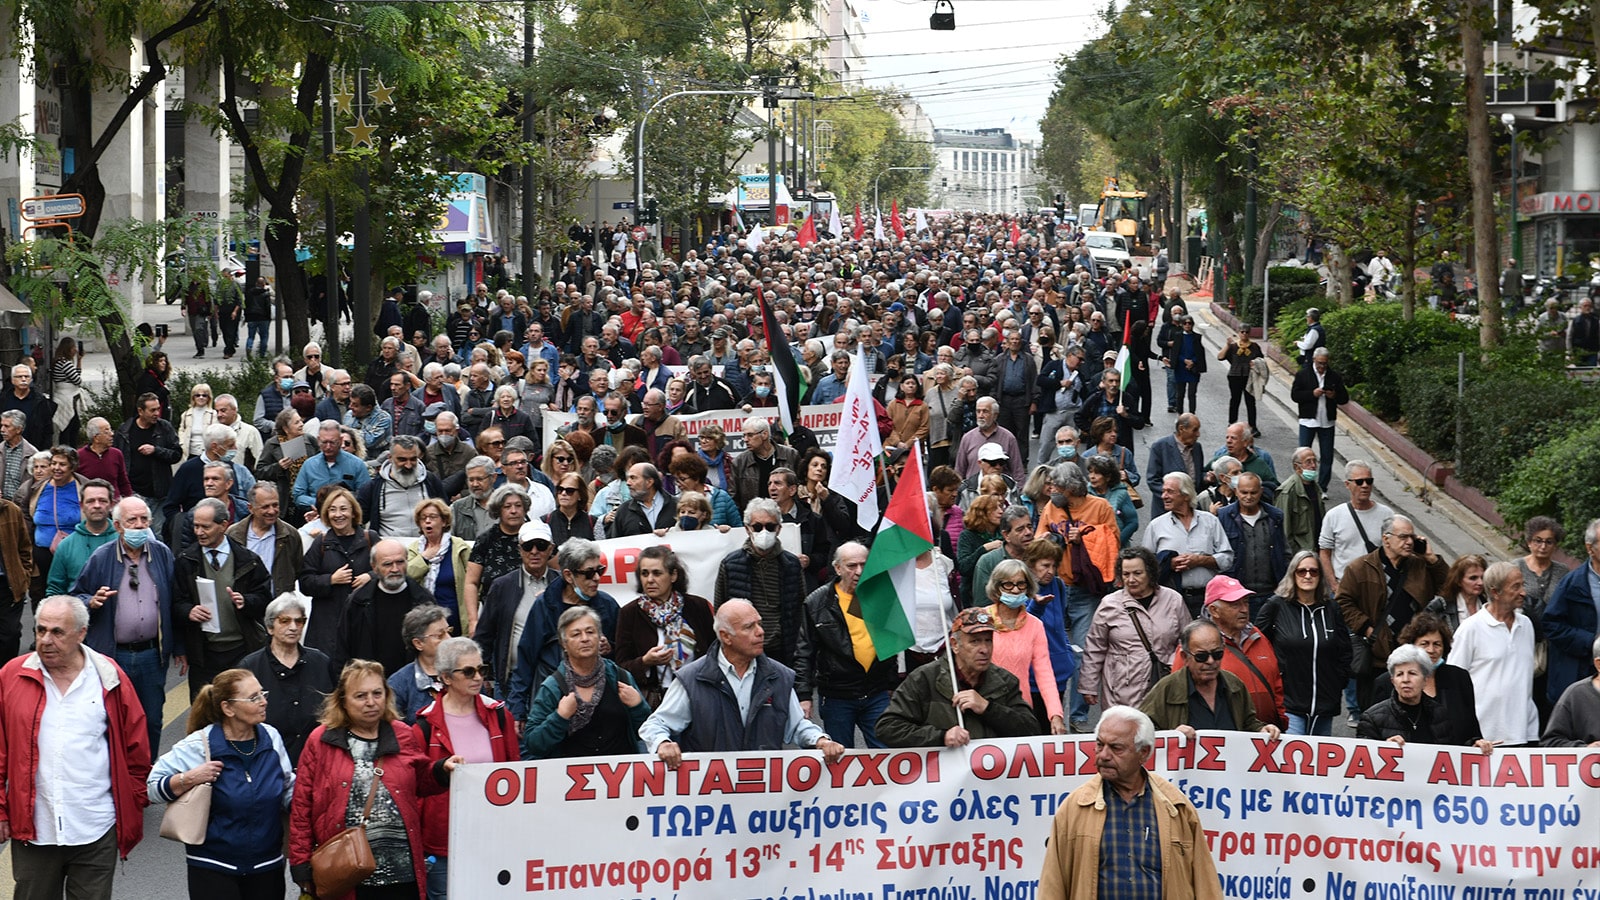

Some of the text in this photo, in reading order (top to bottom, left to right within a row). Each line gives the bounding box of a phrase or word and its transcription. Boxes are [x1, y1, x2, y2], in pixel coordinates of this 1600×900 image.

[485, 767, 538, 807] ΟΙ
[565, 751, 941, 801] ΣΥΝΤΑΞΙΟΥΧΟΙ
[1248, 737, 1405, 782] ΧΩΡΑΣ
[647, 804, 738, 838] ΤΩΡΑ
[748, 797, 888, 839] αυξήσεις
[899, 799, 939, 824] σε
[950, 788, 1020, 826] όλες
[1241, 788, 1273, 820] με
[1283, 785, 1422, 830] κατώτερη
[1433, 794, 1488, 825] 650
[1500, 795, 1580, 834] ευρώ
[525, 847, 713, 893] Επαναφορά
[876, 833, 1024, 872] Σύνταξης
[1264, 831, 1442, 873] προστασίας
[1451, 844, 1497, 874] για
[1507, 846, 1562, 877] την
[1326, 871, 1357, 900] Να
